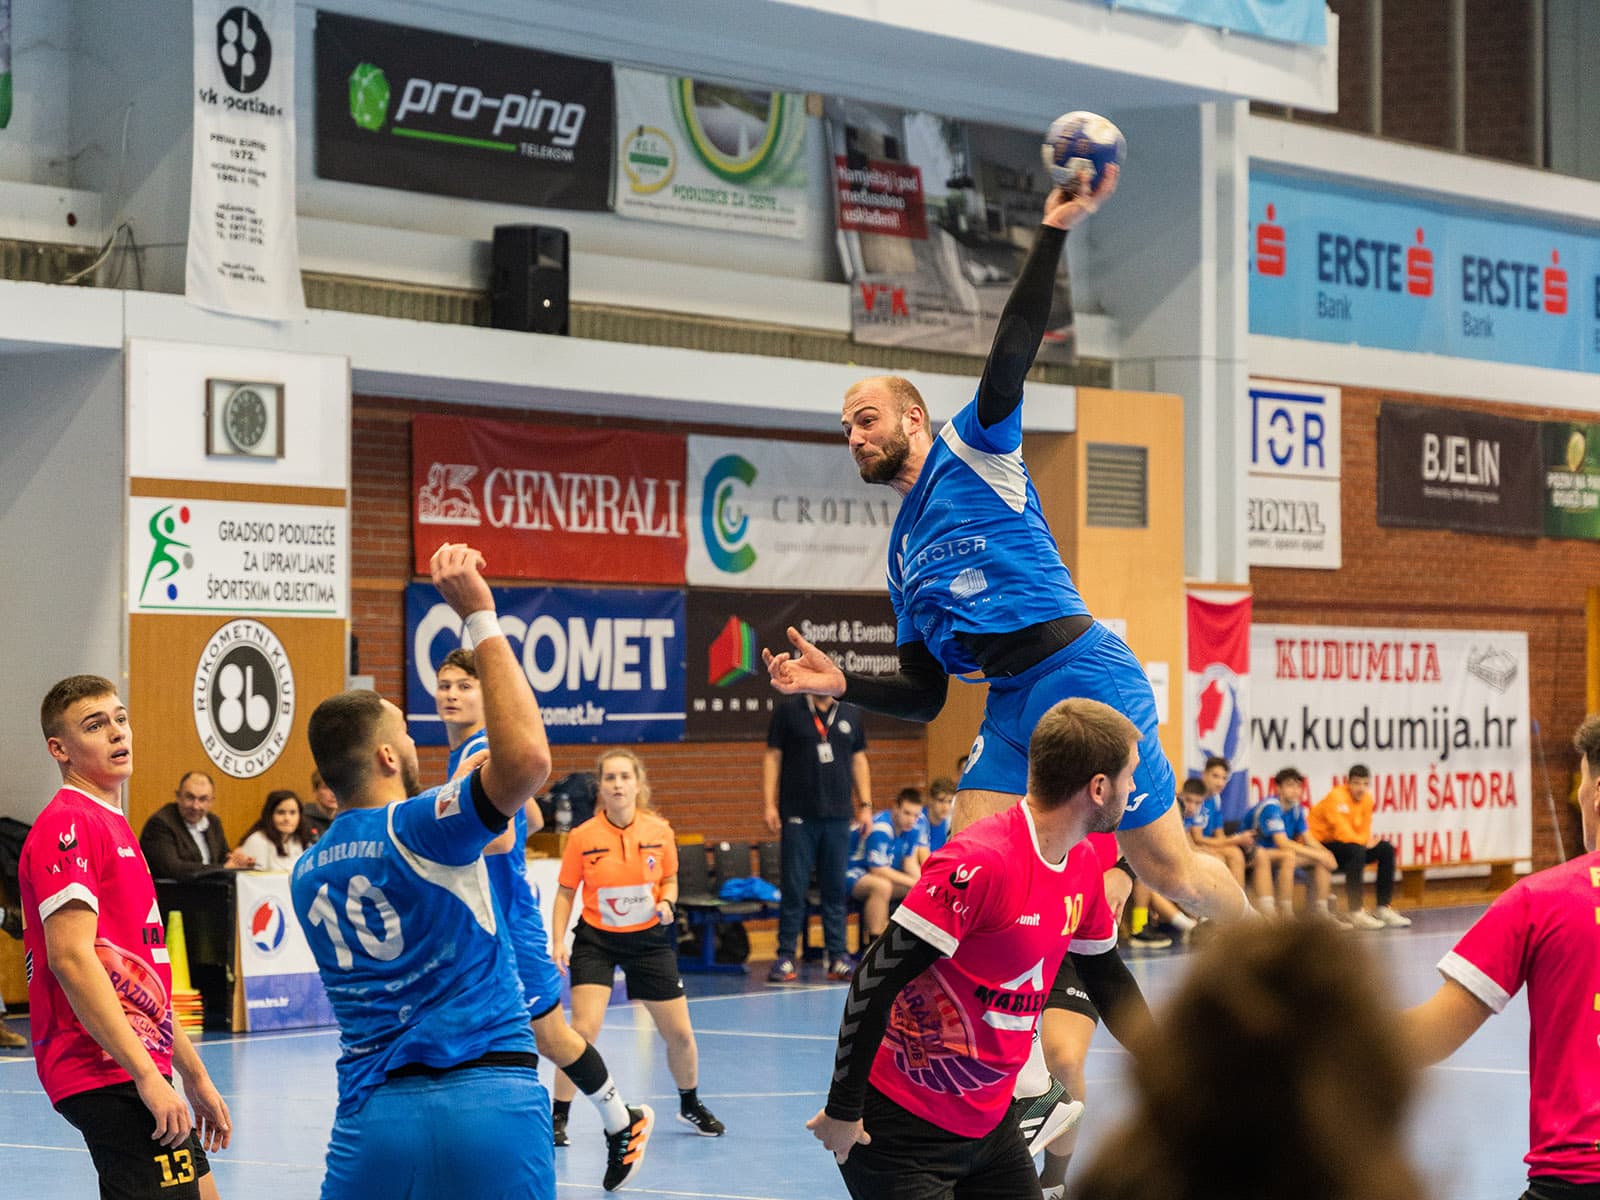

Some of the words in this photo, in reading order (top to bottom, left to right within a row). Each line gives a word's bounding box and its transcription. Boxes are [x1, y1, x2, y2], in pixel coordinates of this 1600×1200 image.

[394, 77, 587, 147] pro-ping
[1317, 232, 1402, 293] ERSTE
[1462, 255, 1539, 311] ERSTE
[1317, 292, 1352, 321] Bank
[1462, 311, 1494, 339] Bank
[1422, 432, 1500, 486] BJELIN
[483, 467, 682, 539] GENERALI
[218, 520, 275, 543] GRADSKO
[279, 519, 336, 546] PODUZEĆE
[243, 551, 259, 571] ZA
[262, 552, 336, 575] UPRAVLJANJE
[206, 573, 270, 601] ŠPORTSKIM
[274, 580, 336, 603] OBJEKTIMA
[801, 619, 838, 644] Sport
[838, 620, 852, 643] &
[852, 620, 896, 644] Events
[197, 624, 271, 711] RUKOMETNI
[271, 646, 291, 716] KLUB
[1275, 639, 1442, 684] KUDUMIJA
[540, 699, 605, 726] omet.hr
[205, 731, 284, 774] BJELOVAR
[1427, 762, 1518, 811] ŠATORA
[307, 874, 405, 971] 10
[153, 1148, 195, 1189] 13
